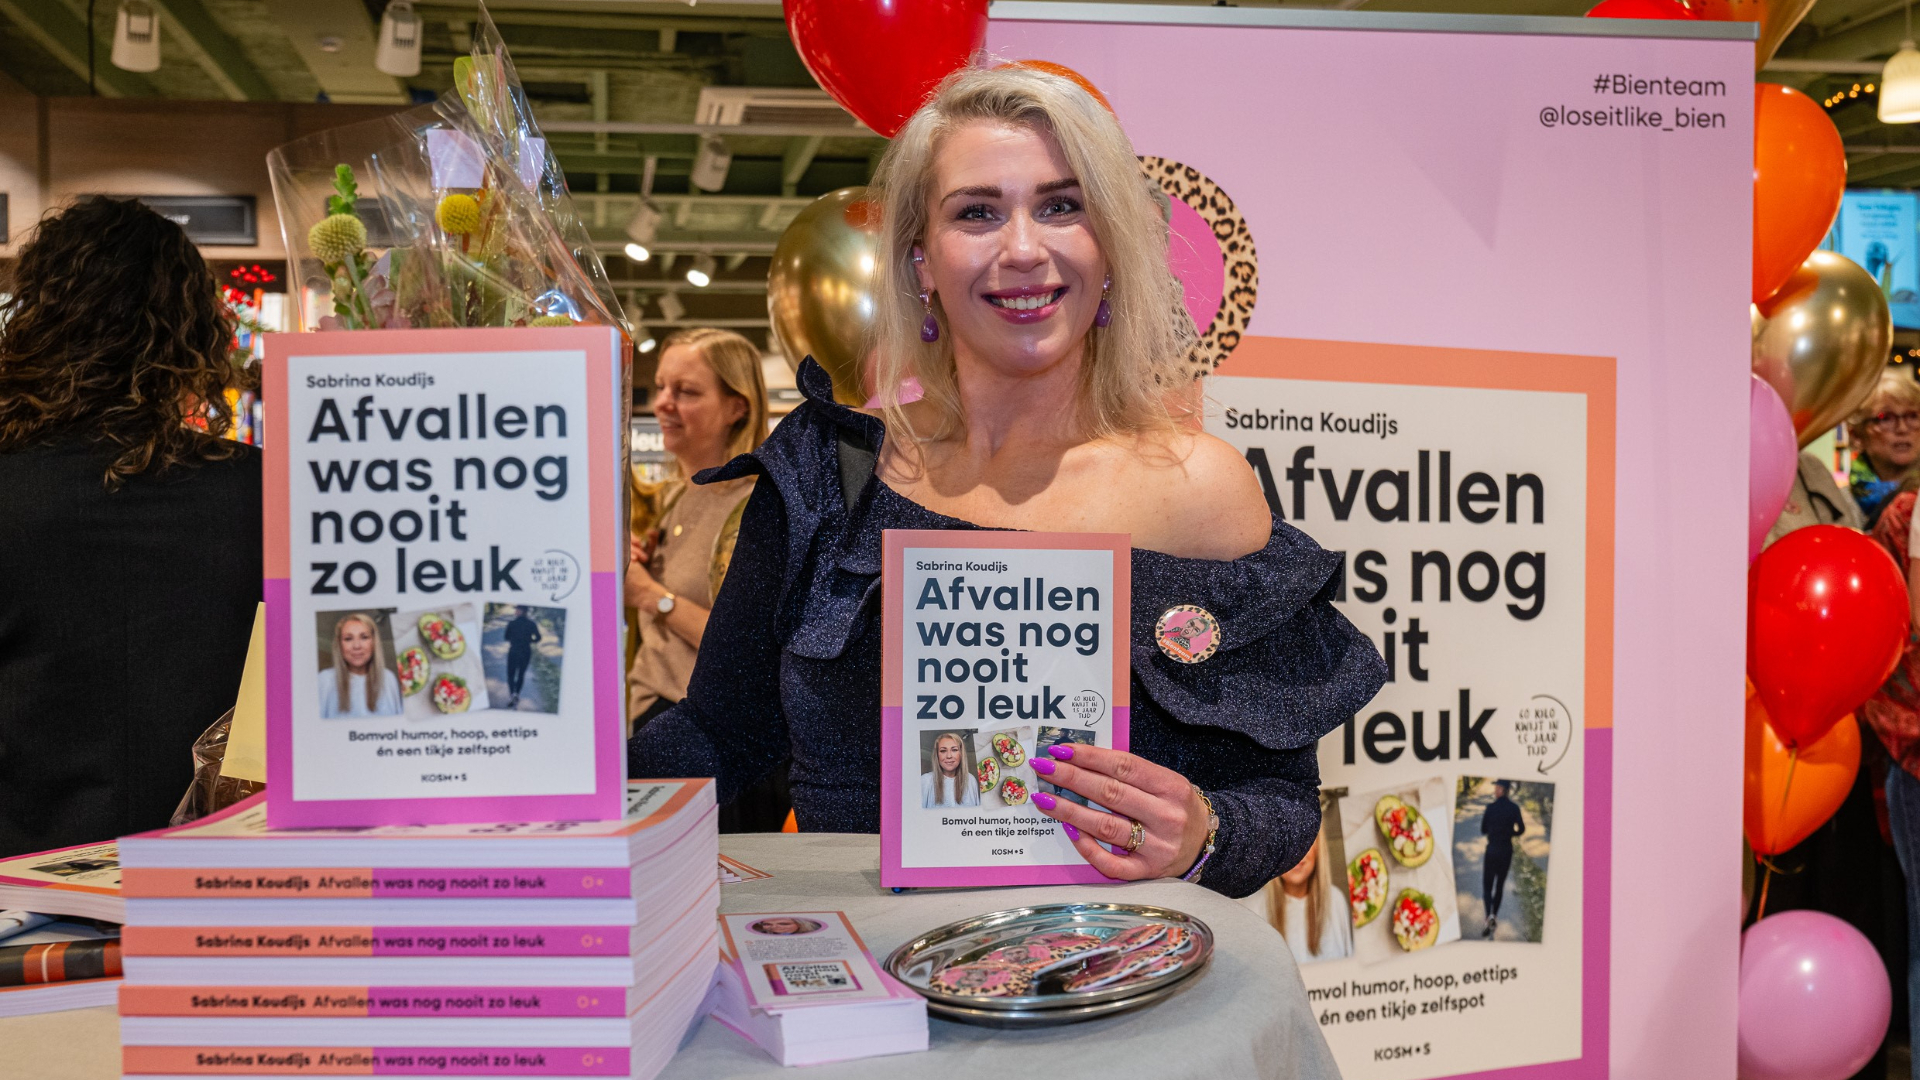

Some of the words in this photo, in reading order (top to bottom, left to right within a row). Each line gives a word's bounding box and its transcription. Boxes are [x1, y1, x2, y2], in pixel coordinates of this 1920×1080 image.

[1593, 74, 1726, 96] #Bienteam
[1539, 105, 1726, 132] @loseitlike_bien
[306, 374, 371, 388] Sabrina
[375, 373, 436, 389] Koudijs
[308, 394, 568, 443] Afvallen
[1225, 408, 1313, 432] Sabrina
[1320, 412, 1398, 439] Koudijs
[309, 455, 433, 493] was
[455, 455, 568, 501] nog
[311, 494, 467, 544] nooit
[311, 560, 377, 595] zo
[397, 546, 523, 593] leuk
[916, 561, 963, 572] Sabrina
[965, 561, 1008, 573] Koudijs
[915, 576, 1100, 611] Afvallen
[1411, 550, 1546, 622] nog
[916, 621, 1005, 647] was
[1019, 622, 1100, 656] nog
[917, 648, 1028, 683] nooit
[916, 694, 965, 720] zo
[977, 686, 1066, 720] leuk
[349, 730, 398, 742] Bomvol
[401, 730, 448, 741] humor,
[451, 729, 489, 740] hoop,
[491, 727, 539, 740] eettips
[1343, 688, 1498, 765] leuk
[377, 746, 393, 757] én
[396, 747, 422, 757] een
[425, 745, 454, 758] tikje
[457, 744, 511, 756] zelfspot
[941, 817, 977, 826] Bomvol
[978, 816, 1011, 826] humor,
[1013, 816, 1039, 826] hoop,
[961, 828, 973, 837] én
[975, 829, 993, 837] een
[995, 828, 1016, 838] tikje
[1017, 828, 1055, 837] zelfspot
[196, 876, 252, 889] Sabrina
[256, 876, 309, 891] Koudijs
[318, 877, 379, 889] Afvallen
[383, 879, 413, 889] was
[417, 879, 446, 891] nog
[450, 876, 488, 889] nooit
[493, 879, 510, 889] zo
[514, 876, 545, 889] leuk
[196, 935, 252, 948] Sabrina
[257, 935, 310, 950] Koudijs
[318, 936, 379, 948] Afvallen
[384, 937, 413, 948] was
[418, 937, 446, 950] nog
[451, 935, 489, 948] nooit
[494, 937, 510, 948] zo
[514, 935, 546, 948] leuk
[1307, 981, 1347, 1001] mvol
[1352, 975, 1410, 997] humor,
[1413, 974, 1459, 993] hoop,
[1463, 964, 1518, 986] eettips
[191, 995, 248, 1008] Sabrina
[252, 995, 305, 1010] Koudijs
[314, 996, 375, 1008] Afvallen
[379, 998, 409, 1008] was
[413, 998, 442, 1010] nog
[446, 995, 484, 1008] nooit
[489, 998, 505, 1008] zo
[510, 995, 541, 1008] leuk
[1320, 1007, 1340, 1026] én
[1345, 1008, 1377, 1023] een
[1381, 999, 1416, 1021] tikje
[1420, 993, 1485, 1015] zelfspot
[196, 1053, 253, 1066] Sabrina
[257, 1053, 310, 1068] Koudijs
[319, 1054, 380, 1066] Afvallen
[384, 1055, 414, 1066] was
[418, 1055, 447, 1068] nog
[451, 1053, 489, 1066] nooit
[494, 1055, 510, 1066] zo
[515, 1053, 546, 1066] leuk
